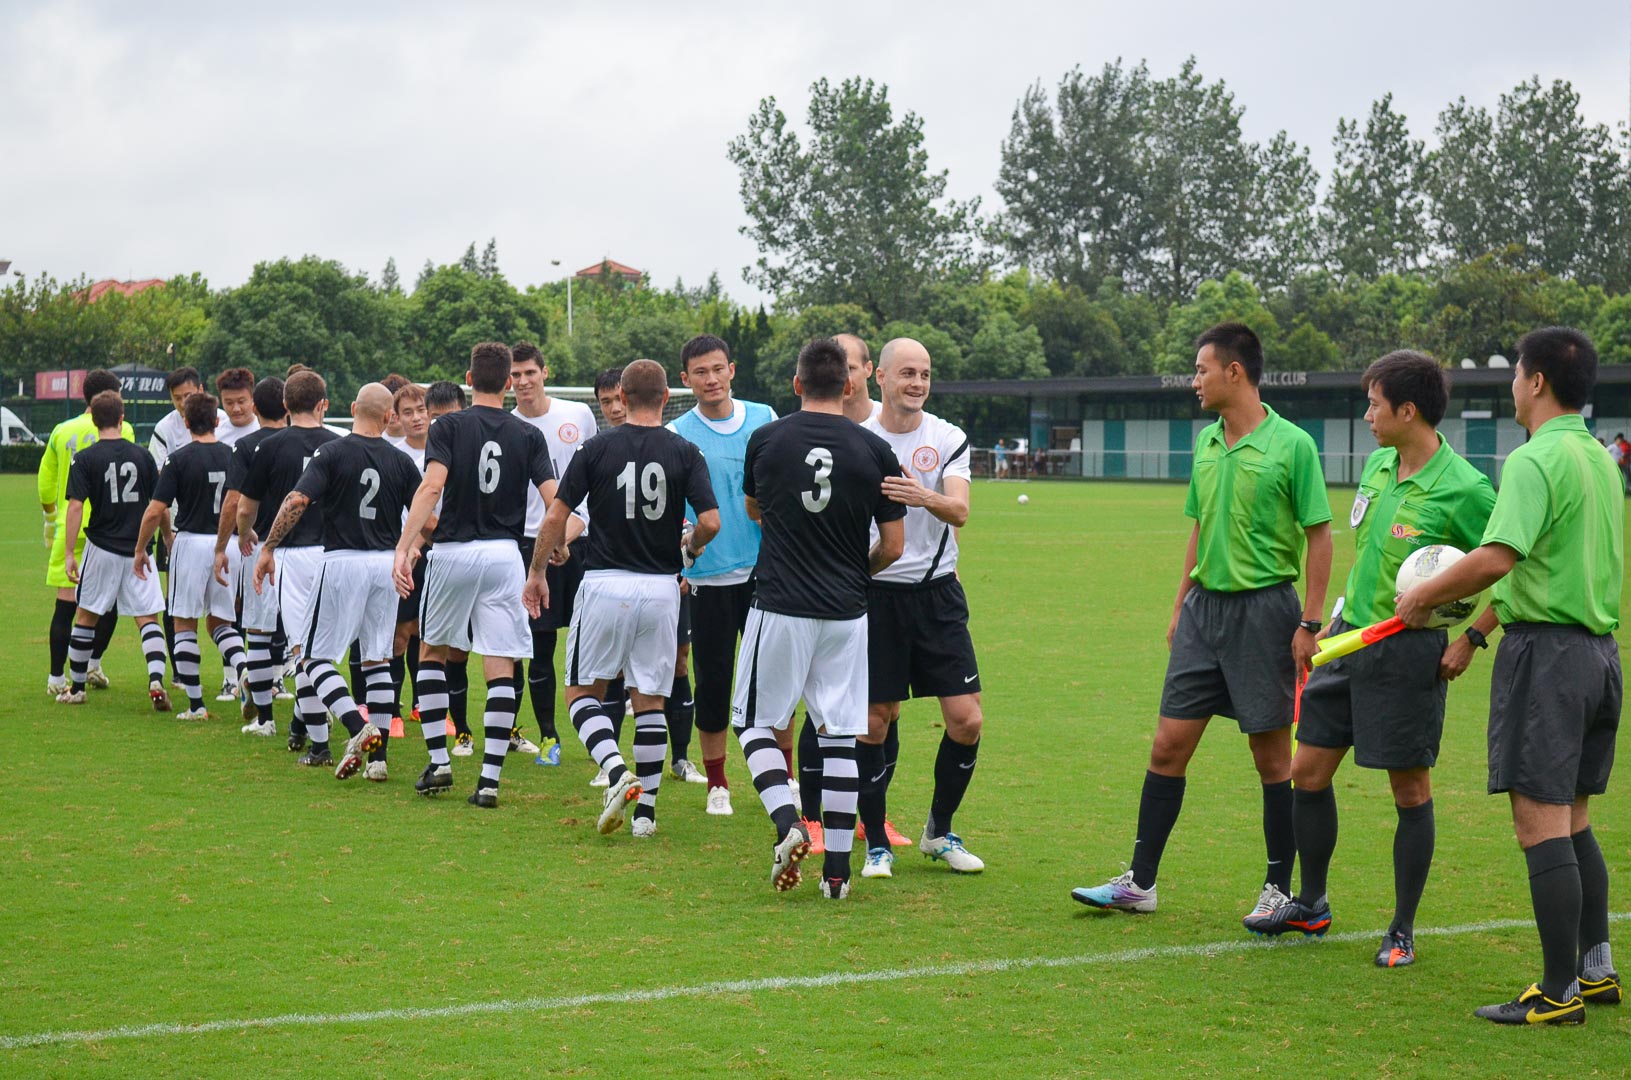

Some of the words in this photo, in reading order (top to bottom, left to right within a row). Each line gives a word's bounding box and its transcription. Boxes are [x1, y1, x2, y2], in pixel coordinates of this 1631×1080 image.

[1259, 372, 1278, 386] ALL
[1280, 371, 1307, 386] CLUB
[104, 461, 140, 503] 12
[208, 471, 226, 514] 7
[478, 440, 502, 494] 6
[616, 461, 667, 521] 19
[801, 447, 834, 513] 3
[359, 468, 381, 520] 2
